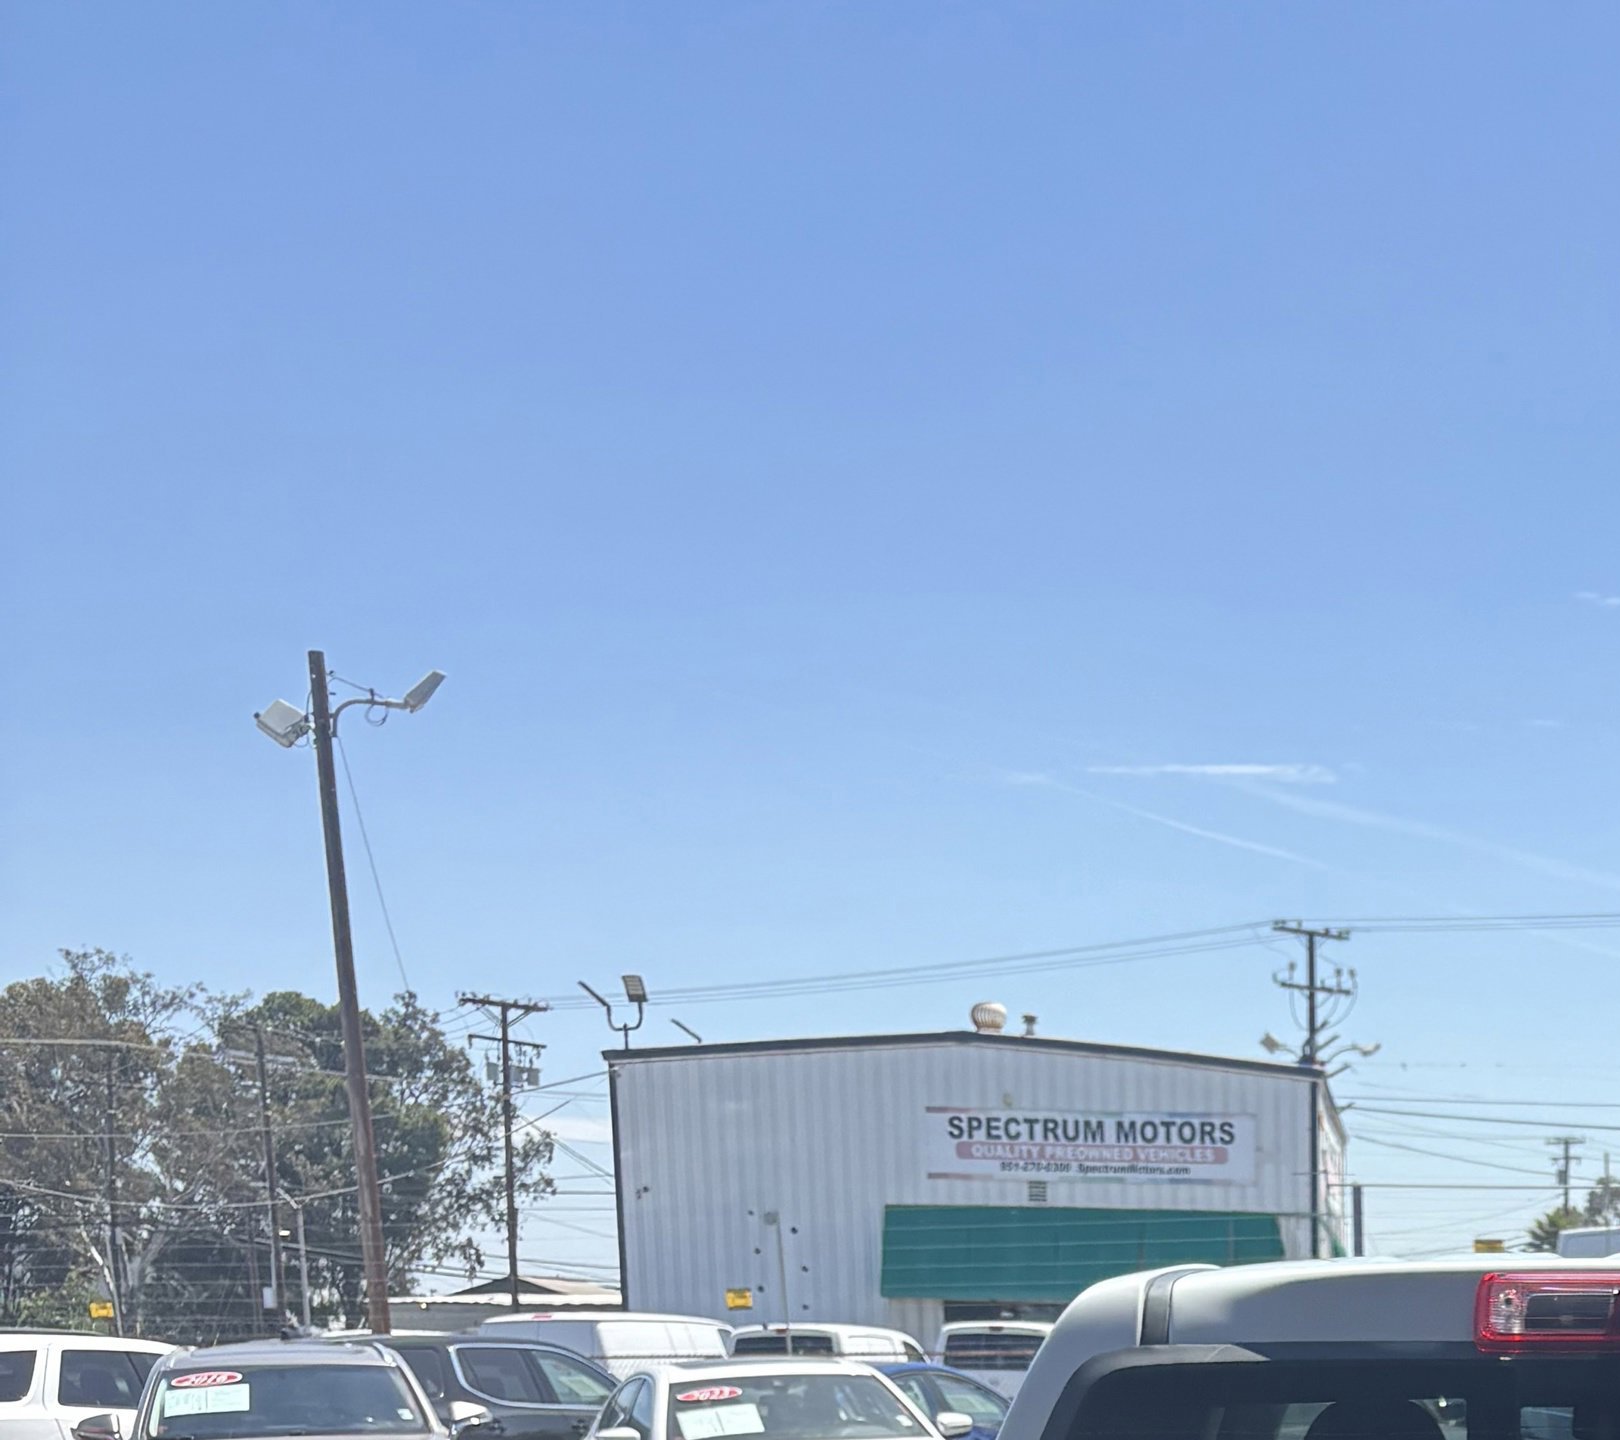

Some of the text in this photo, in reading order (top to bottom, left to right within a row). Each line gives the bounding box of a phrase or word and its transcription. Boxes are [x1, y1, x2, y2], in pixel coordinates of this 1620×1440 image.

[947, 1115, 1236, 1146] SPECTRUM MOTORS
[971, 1145, 1216, 1163] QUALITY PREOWNED VEHICLES
